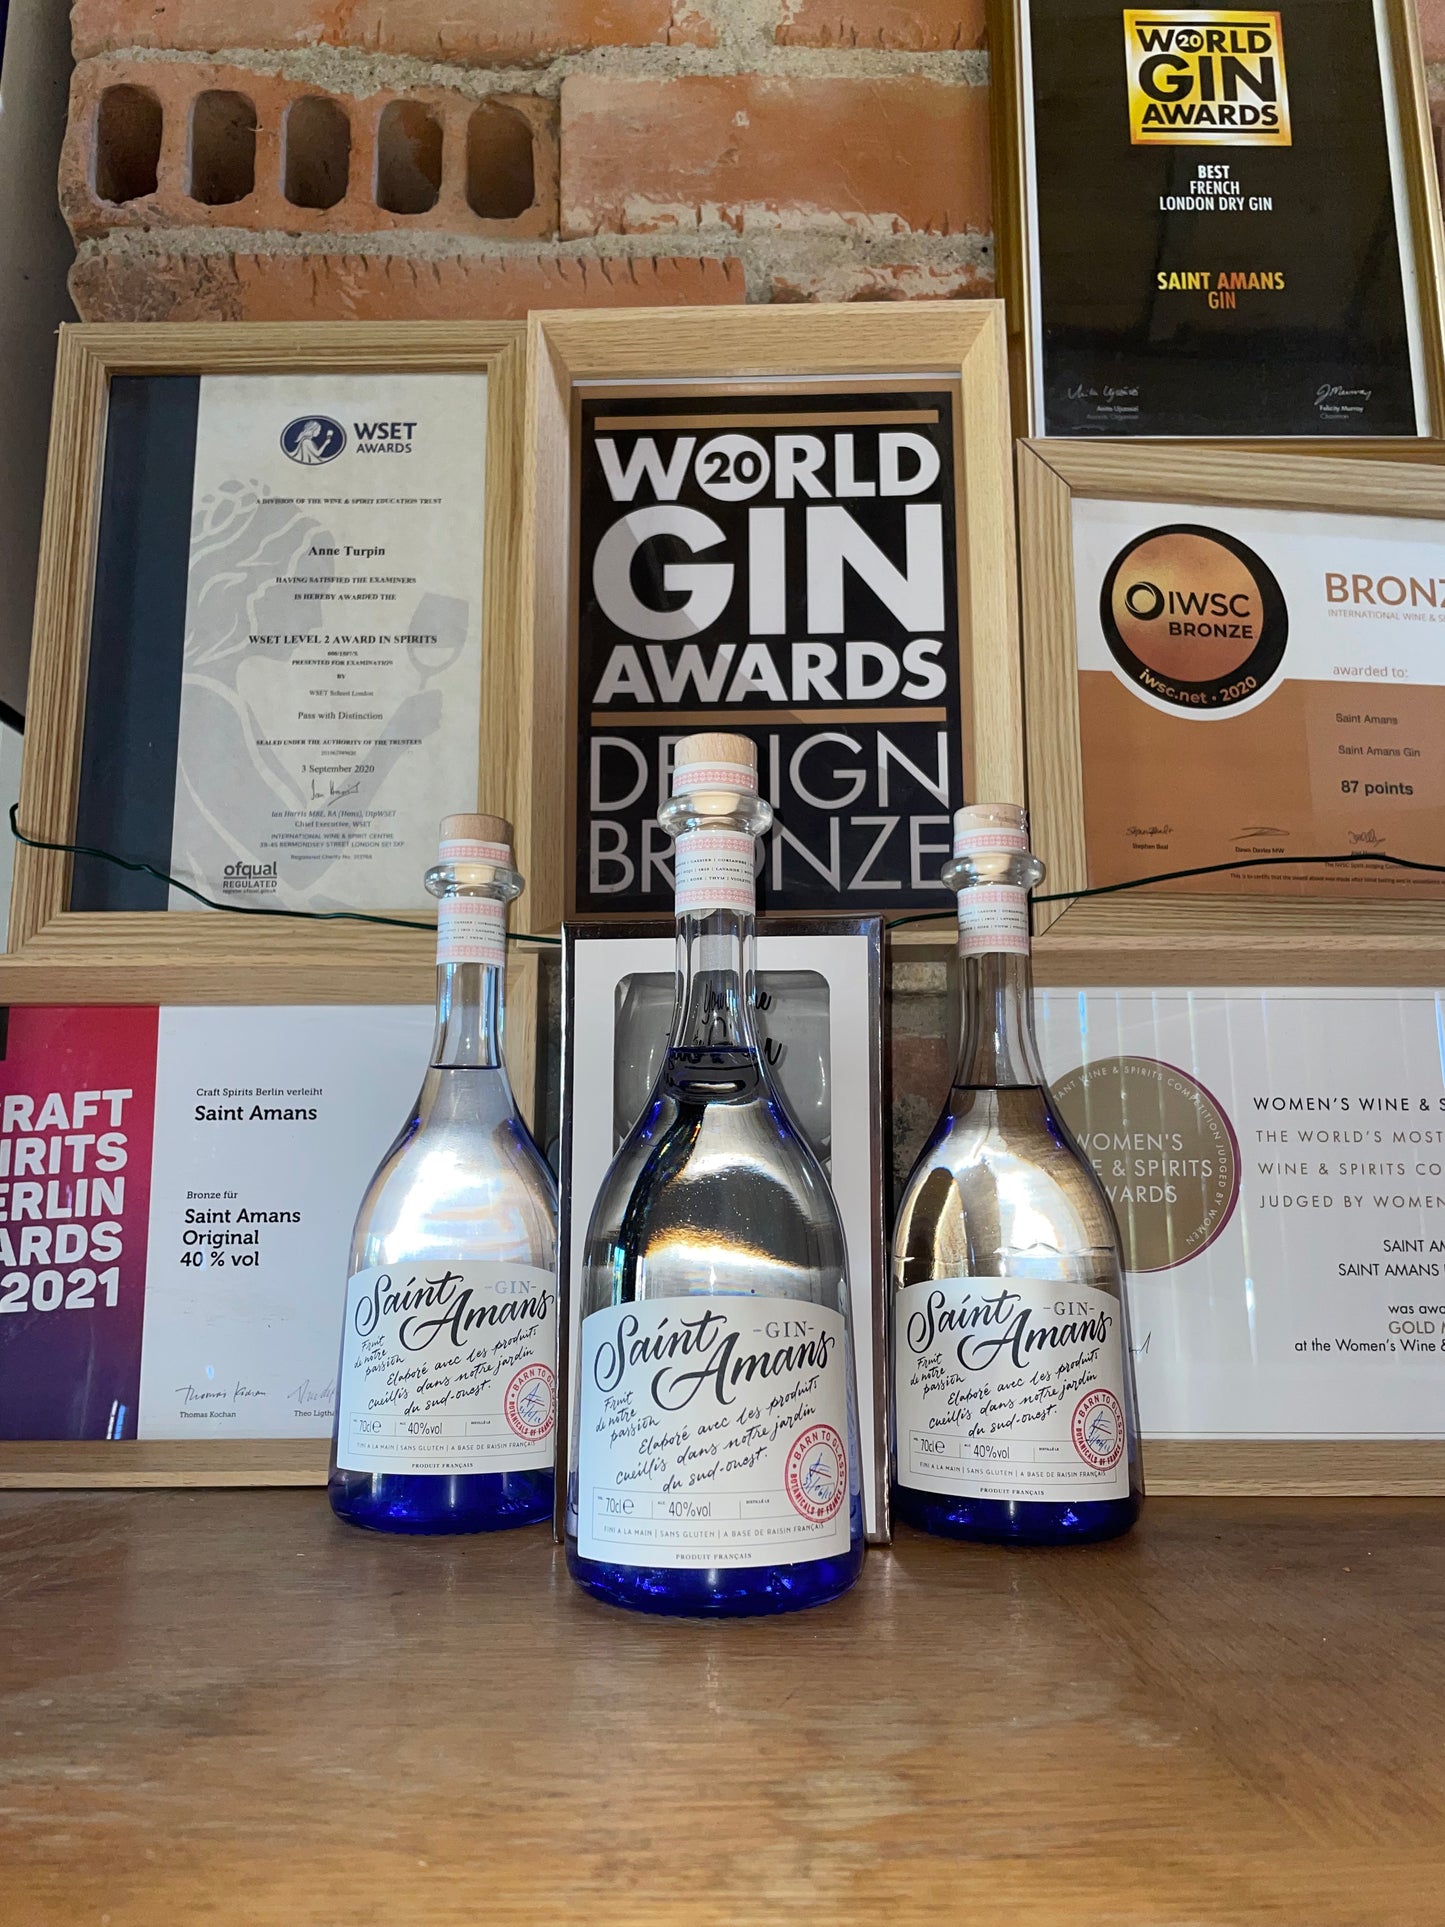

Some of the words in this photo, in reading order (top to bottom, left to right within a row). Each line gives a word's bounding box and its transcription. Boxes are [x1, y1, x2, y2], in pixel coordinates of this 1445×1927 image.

[1138, 54, 1277, 102] GIN
[1142, 104, 1278, 126] AWARDS
[1198, 165, 1230, 179] BEST
[1190, 181, 1240, 194] FRENCH
[1160, 196, 1214, 210] LONDON
[1219, 197, 1244, 211] DRY
[1249, 197, 1272, 211] GIN
[1157, 272, 1210, 290] SAINT
[1217, 272, 1285, 290] AMANS
[1208, 291, 1236, 309] GIN
[354, 423, 417, 440] WSET
[356, 443, 412, 453] AWARDS
[308, 546, 339, 556] Anne
[344, 546, 385, 558] Turpin
[592, 504, 945, 641] GIN
[1169, 592, 1250, 617] IWSC
[1328, 610, 1400, 620] INTERNATIONAL
[1403, 613, 1425, 621] WINE
[1169, 622, 1253, 639] BRONZE
[249, 635, 281, 644] WSET
[284, 635, 321, 644] LEVEL
[324, 635, 329, 644] 2
[333, 635, 376, 644] AWARD
[379, 636, 390, 644] IN
[394, 635, 437, 644] SPIRITS
[592, 639, 947, 704] AWARDS
[1333, 666, 1388, 677] awarded
[1392, 668, 1408, 678] to:
[1139, 669, 1208, 704] iwsc.net
[1220, 676, 1257, 701] 2020
[298, 712, 315, 720] Pass
[338, 712, 383, 720] Distinction
[1336, 713, 1361, 723] Saint
[1364, 715, 1398, 724] Amans
[1338, 745, 1363, 755] Saint
[1367, 747, 1400, 756] Amans
[1404, 748, 1420, 757] Gin
[309, 765, 352, 775] September
[590, 730, 949, 812] DIGN
[1341, 780, 1358, 793] 87
[1365, 781, 1413, 796] points
[590, 815, 956, 894] BRNZE
[224, 861, 277, 879] ofqual
[1124, 1066, 1163, 1080] SPIRITS
[197, 1088, 220, 1096] Craft
[223, 1088, 253, 1098] Spirits
[256, 1088, 284, 1096] Berlin
[287, 1088, 322, 1096] verleiht
[0, 1089, 133, 1133] RAFT
[195, 1105, 243, 1120] Saint
[249, 1105, 317, 1120] Amans
[1359, 1098, 1409, 1111] WINE
[1420, 1098, 1430, 1111] &
[1256, 1130, 1288, 1142] THE
[1393, 1131, 1442, 1143] MOST
[1113, 1161, 1125, 1176] &
[1135, 1160, 1212, 1176] SPIRITS
[1258, 1162, 1308, 1175] WINE
[1319, 1163, 1328, 1175] &
[1340, 1163, 1405, 1175] SPIRITS
[187, 1191, 221, 1199] Bronze
[224, 1191, 238, 1199] für
[1260, 1195, 1333, 1208] JUDGED
[1345, 1195, 1363, 1207] BY
[1373, 1195, 1445, 1208] WOMEN
[185, 1208, 231, 1223] Saint
[236, 1208, 300, 1223] Amans
[183, 1230, 259, 1248] Original
[1384, 1240, 1424, 1252] SAINT
[180, 1251, 203, 1266] 40
[211, 1251, 224, 1266] %
[231, 1251, 259, 1266] vol
[1338, 1264, 1379, 1276] SAINT
[1385, 1264, 1439, 1276] AMANS
[0, 1267, 119, 1313] 2021
[355, 1271, 464, 1336] Saint
[1388, 1306, 1414, 1314] was
[399, 1289, 555, 1351] Amans
[907, 1289, 1021, 1353] Saint
[1389, 1321, 1434, 1334] GOLD
[435, 1356, 462, 1370] avec
[466, 1345, 487, 1362] les
[492, 1325, 539, 1354] produits
[957, 1308, 1113, 1371] Amans
[1295, 1340, 1306, 1351] at
[1312, 1338, 1330, 1351] the
[1400, 1339, 1435, 1351] Wine
[594, 1309, 727, 1392] Saint
[417, 1374, 450, 1394] dans
[454, 1361, 494, 1382] notre
[493, 1347, 534, 1376] jardin
[651, 1330, 835, 1411] Amans
[998, 1378, 1024, 1392] avec
[1030, 1368, 1051, 1386] les
[1055, 1348, 1100, 1379] produits
[604, 1391, 634, 1412] Fruit
[698, 1417, 730, 1434] avec
[736, 1406, 761, 1423] les
[766, 1375, 820, 1415] produits
[608, 1409, 637, 1427] notre
[677, 1442, 718, 1464] dans
[723, 1424, 770, 1450] notre
[771, 1403, 816, 1440] jardin
[794, 1432, 818, 1460] BARN
[822, 1431, 830, 1440] TO
[663, 1475, 683, 1494] du
[668, 1501, 711, 1517] 40%vol
